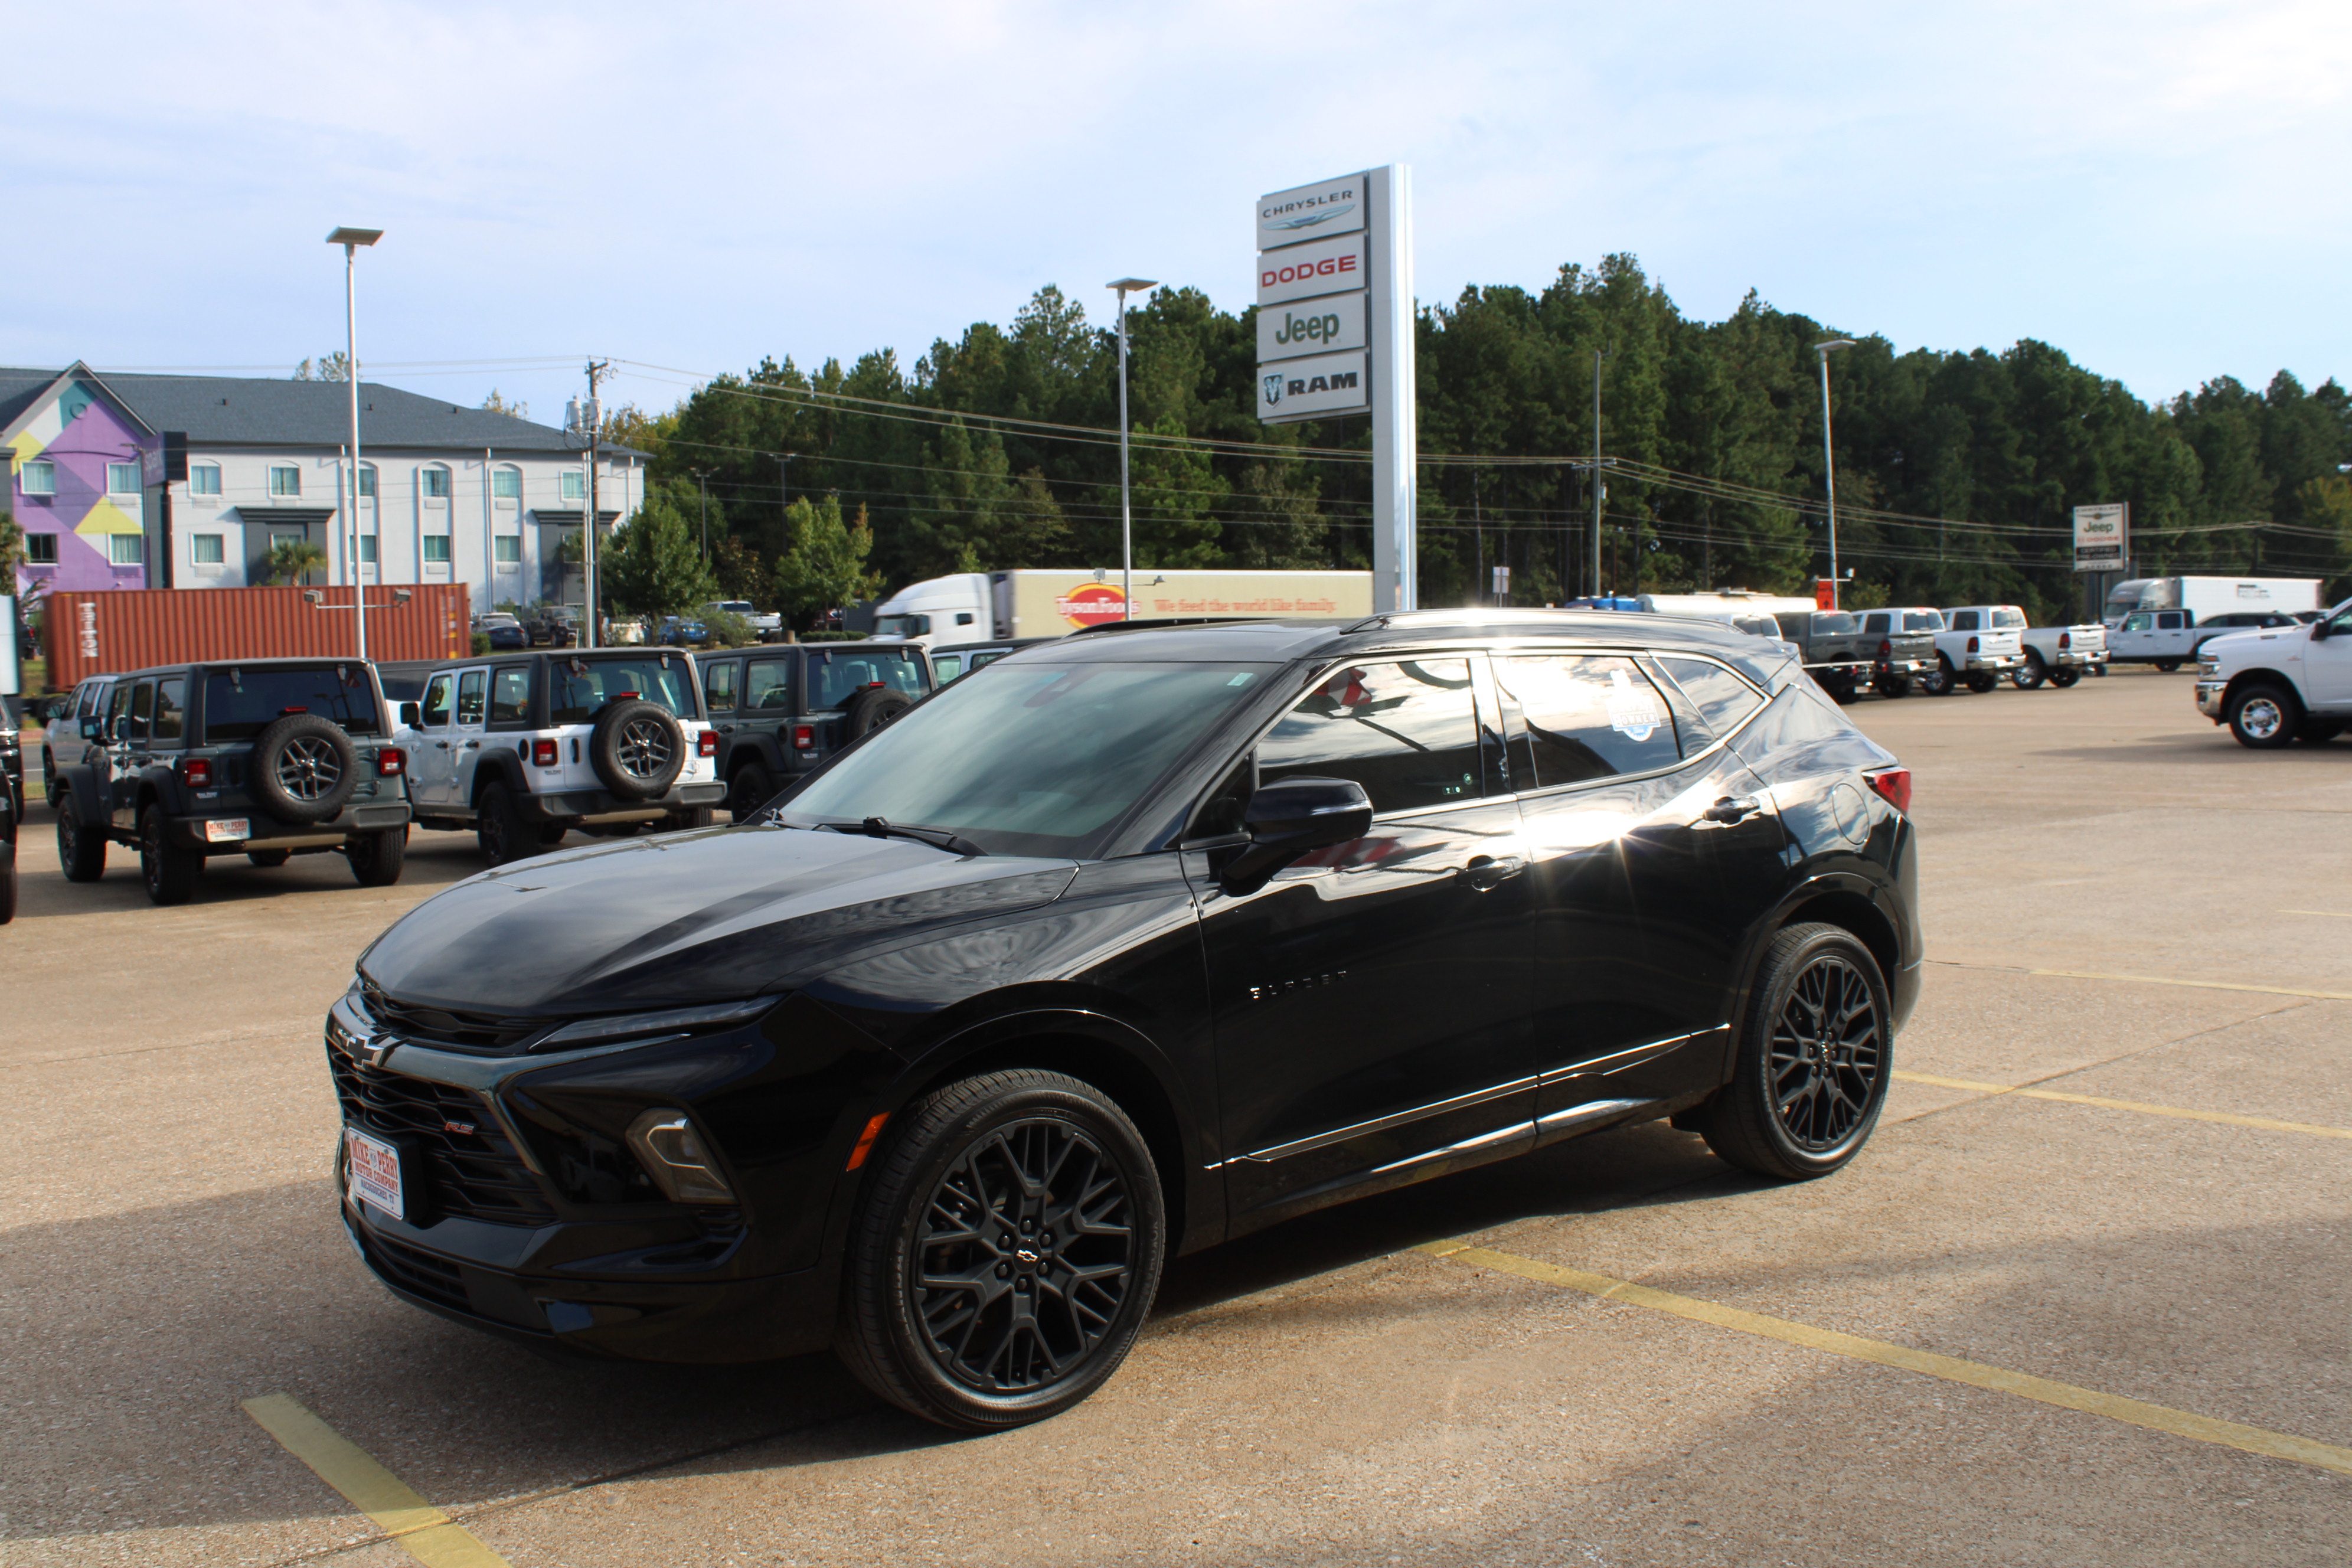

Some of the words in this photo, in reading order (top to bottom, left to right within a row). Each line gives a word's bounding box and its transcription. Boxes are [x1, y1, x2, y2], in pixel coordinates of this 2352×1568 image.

[1262, 190, 1353, 218] CHRYSLER
[1262, 254, 1357, 288] DODGE
[1276, 312, 1340, 345] Jeep
[1288, 371, 1357, 396] RAM
[2083, 521, 2113, 534] Jeep
[1178, 598, 1206, 612] feed
[1208, 598, 1229, 612] the
[1232, 598, 1268, 612] world
[1269, 598, 1293, 612] like
[445, 1121, 475, 1135] RS
[351, 1137, 371, 1166] MIKE
[377, 1150, 399, 1181] PERRY
[355, 1160, 373, 1180] MOTOR
[374, 1171, 399, 1193] COMPANY
